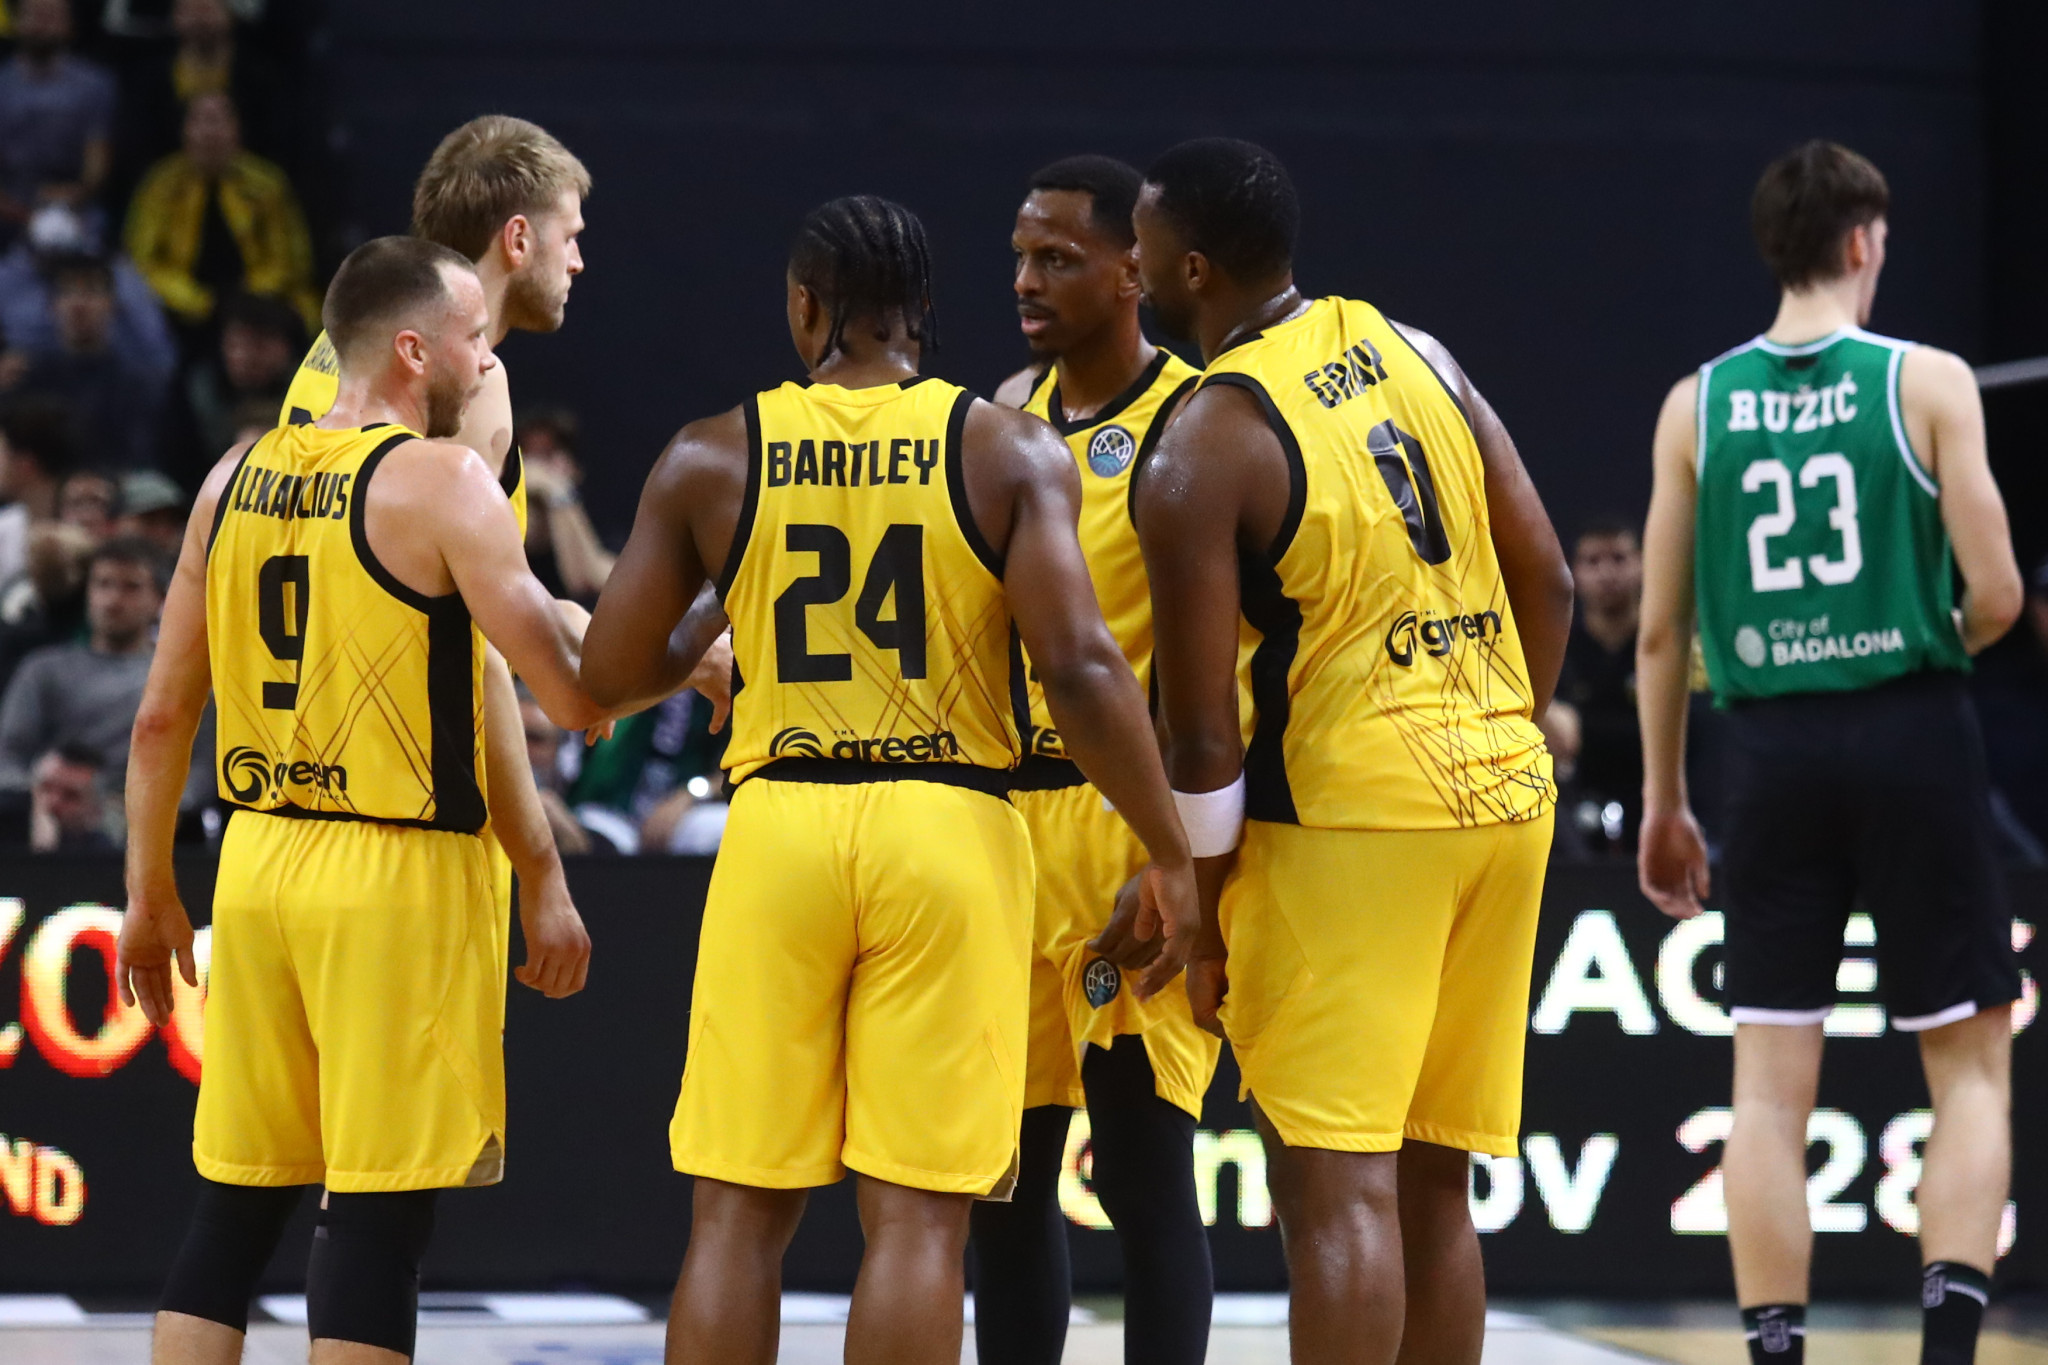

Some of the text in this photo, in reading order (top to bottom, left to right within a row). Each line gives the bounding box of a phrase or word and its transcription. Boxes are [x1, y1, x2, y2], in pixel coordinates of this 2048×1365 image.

[1304, 338, 1388, 409] GRAY
[767, 438, 939, 488] BARTLEY
[1742, 453, 1863, 593] 23
[258, 555, 309, 710] 9
[774, 523, 927, 683] 24
[1768, 613, 1830, 640] City of
[1772, 626, 1905, 666] BADALONA
